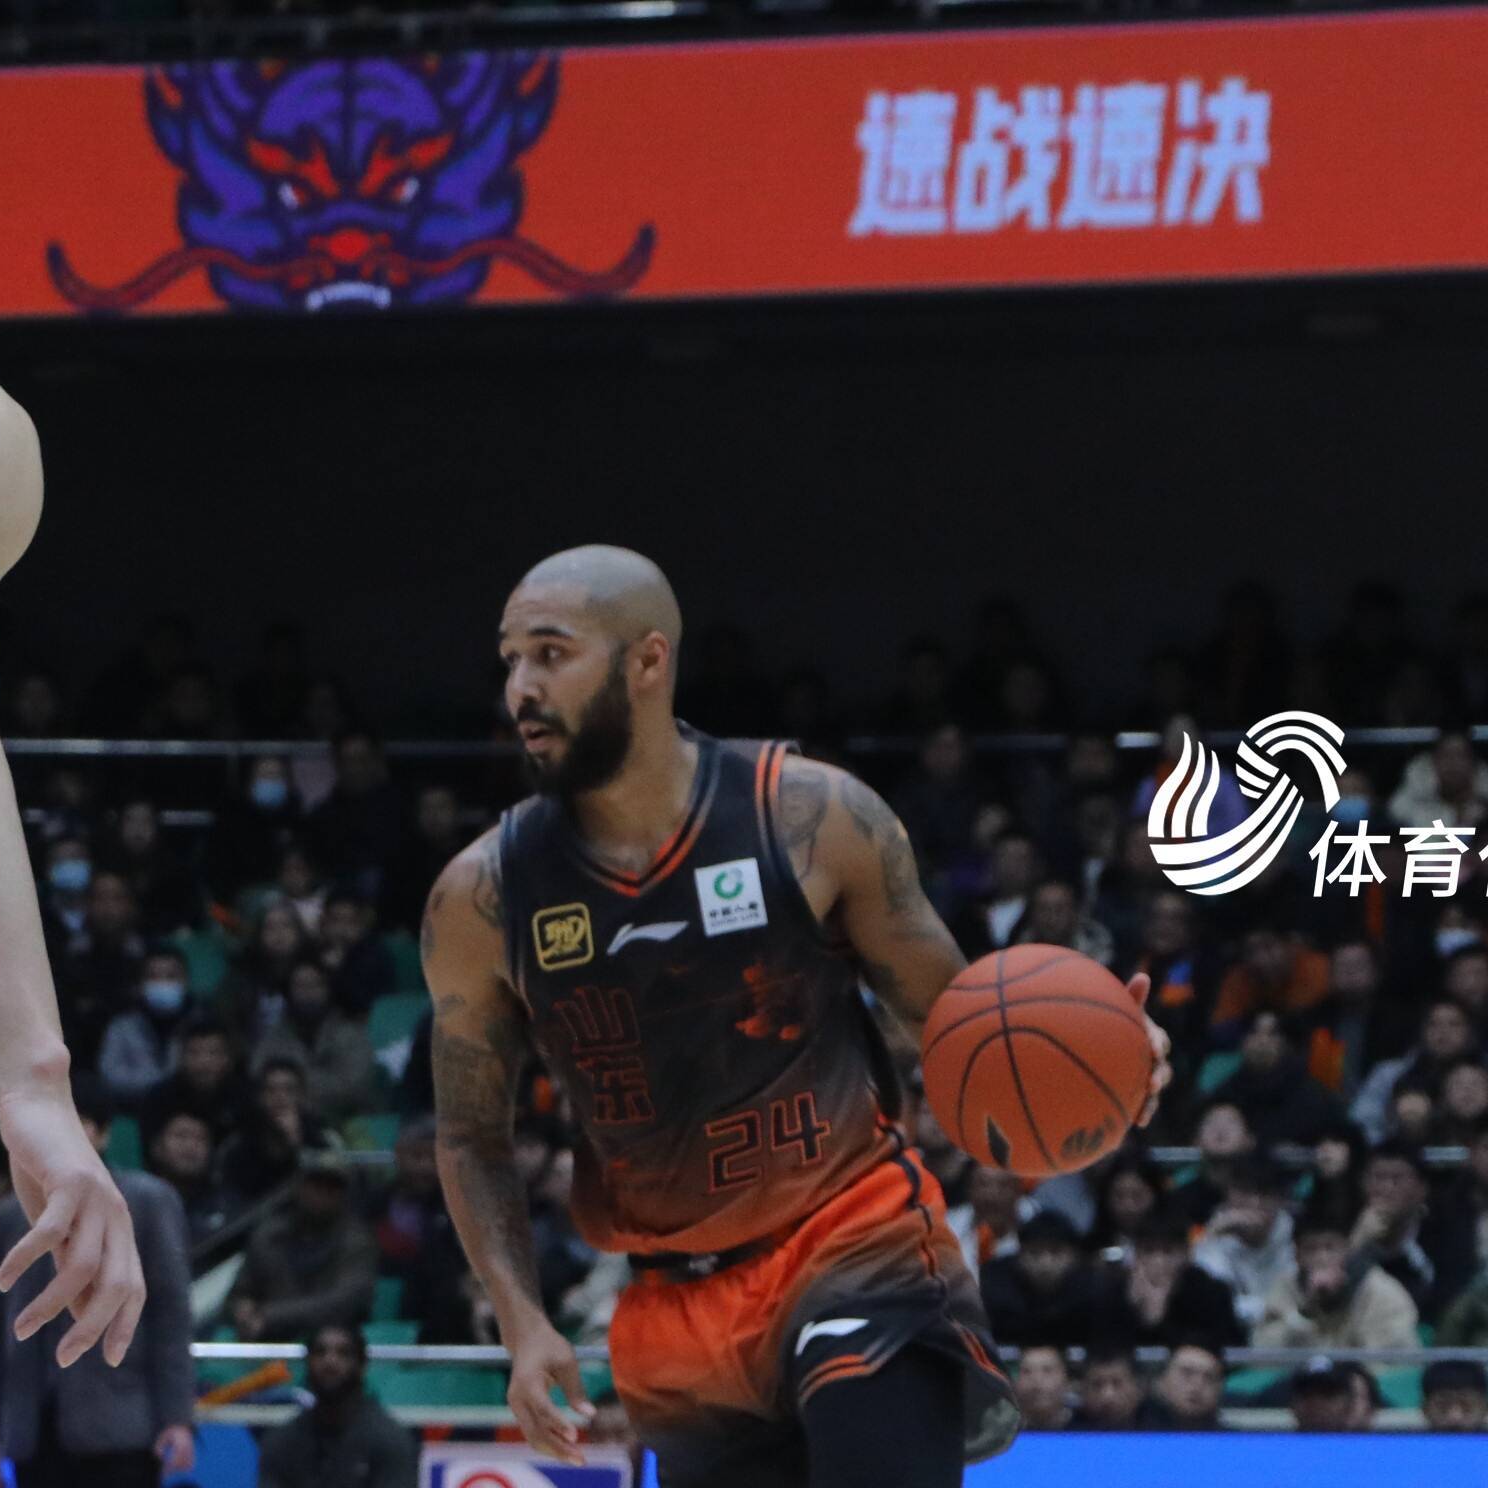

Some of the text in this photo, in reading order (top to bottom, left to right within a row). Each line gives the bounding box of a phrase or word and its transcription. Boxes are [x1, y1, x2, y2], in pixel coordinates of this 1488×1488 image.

[848, 76, 1270, 236] 速战速决
[704, 1091, 832, 1195] 24
